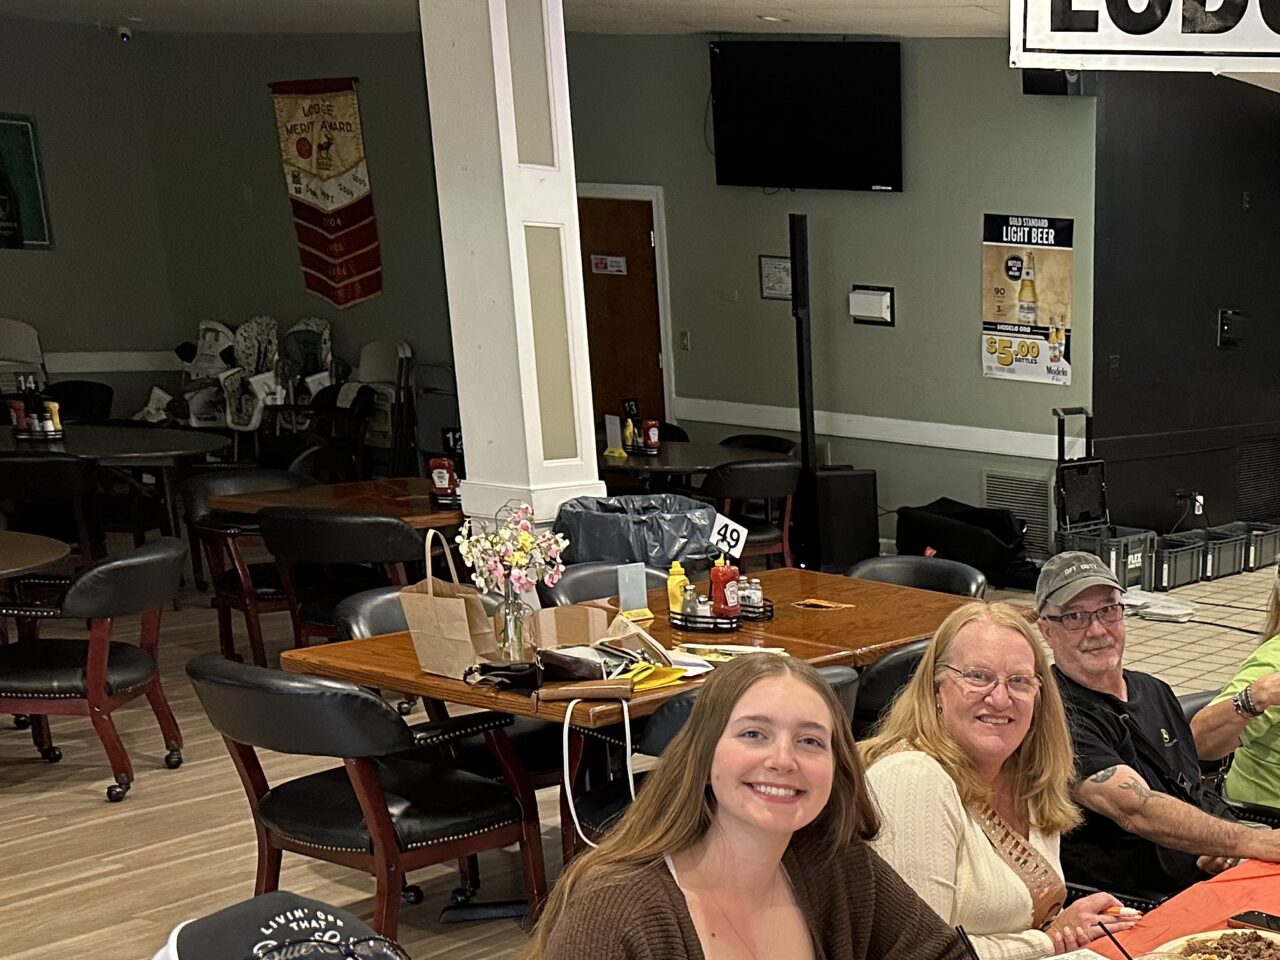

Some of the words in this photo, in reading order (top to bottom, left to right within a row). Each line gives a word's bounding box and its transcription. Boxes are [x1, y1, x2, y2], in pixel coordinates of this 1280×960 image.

[302, 103, 334, 117] LODGE
[286, 121, 315, 135] MERIT
[320, 120, 352, 133] AWARD
[1009, 217, 1022, 226] GOLD
[1023, 218, 1048, 228] STANDARD
[1002, 226, 1030, 242] LIGHT
[1031, 228, 1055, 244] BEER
[994, 287, 1006, 296] 90
[997, 324, 1018, 332] MODELO
[986, 336, 1040, 366] $5.00
[1014, 356, 1038, 365] BOTTLES
[1046, 365, 1068, 377] Modelo
[18, 375, 36, 391] 14
[624, 401, 637, 415] 13
[717, 523, 741, 549] 49
[1128, 552, 1142, 565] FLEX
[260, 908, 309, 935] LIVIN'
[289, 919, 327, 931] THAT
